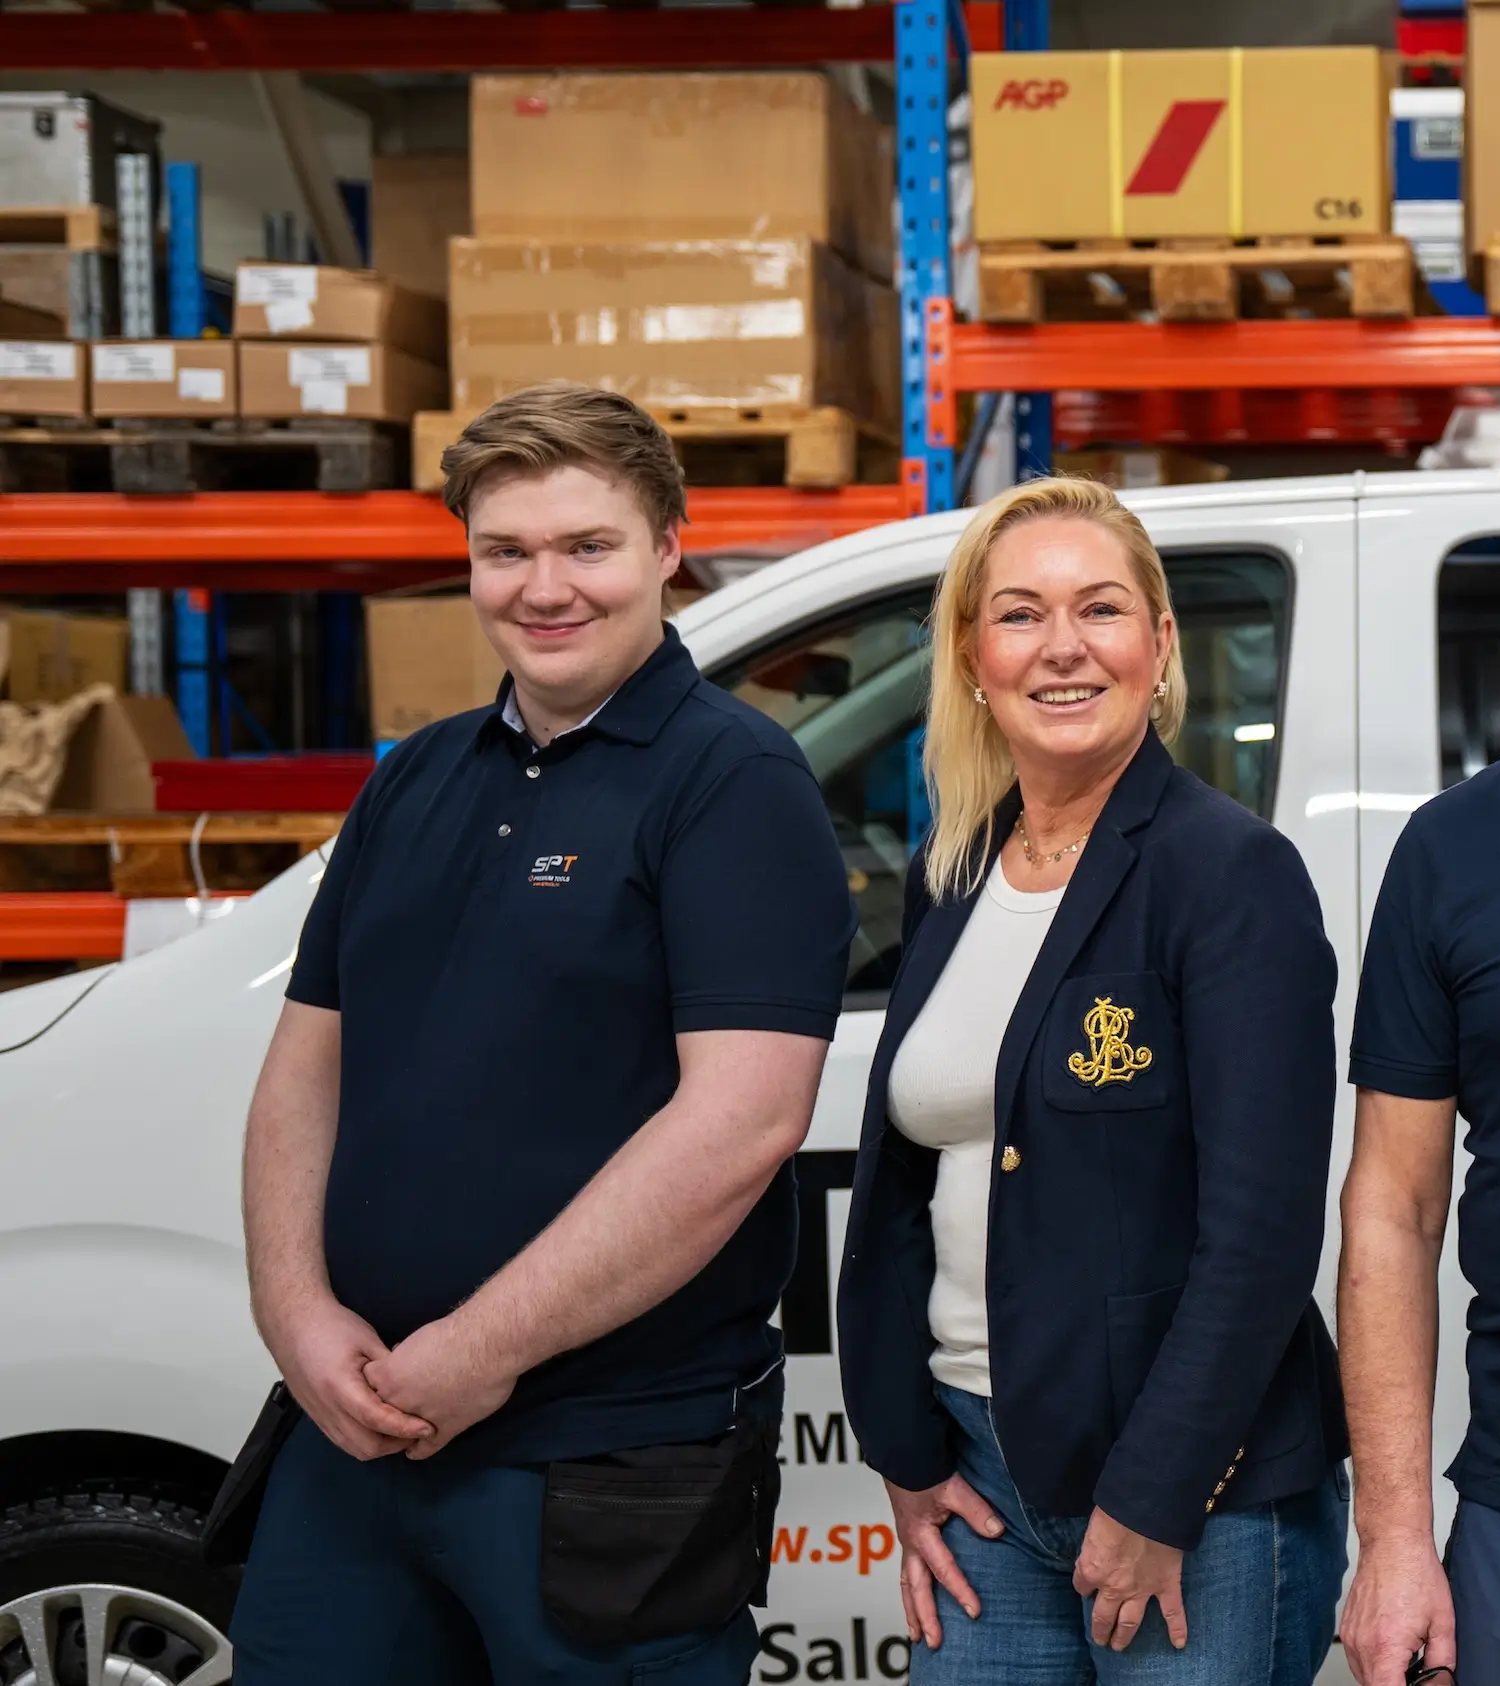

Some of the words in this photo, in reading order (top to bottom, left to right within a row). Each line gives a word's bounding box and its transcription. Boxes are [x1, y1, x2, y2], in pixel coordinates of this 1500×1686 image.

[993, 79, 1069, 111] AGP
[1314, 198, 1363, 220] C16
[531, 855, 579, 873] SPT
